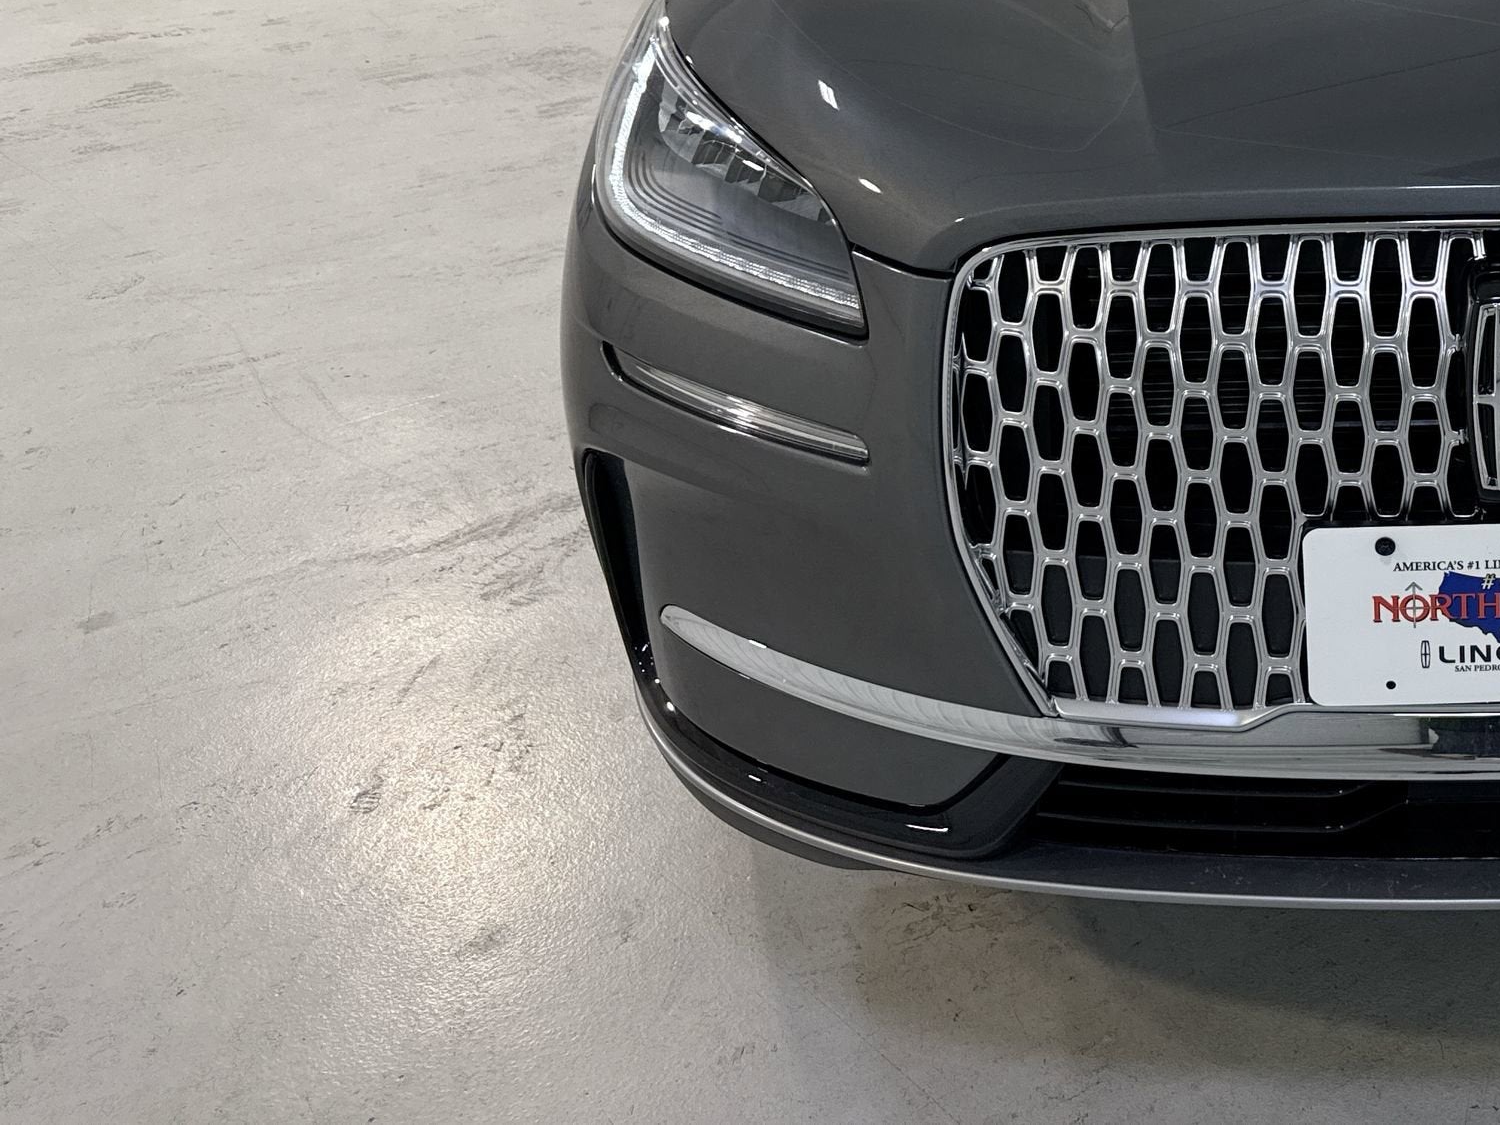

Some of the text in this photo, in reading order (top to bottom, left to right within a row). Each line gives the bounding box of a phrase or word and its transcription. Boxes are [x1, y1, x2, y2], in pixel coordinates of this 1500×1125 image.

[1393, 560, 1464, 572] AMERICA'S
[1467, 560, 1481, 570] #1
[1454, 664, 1472, 672] SAN
